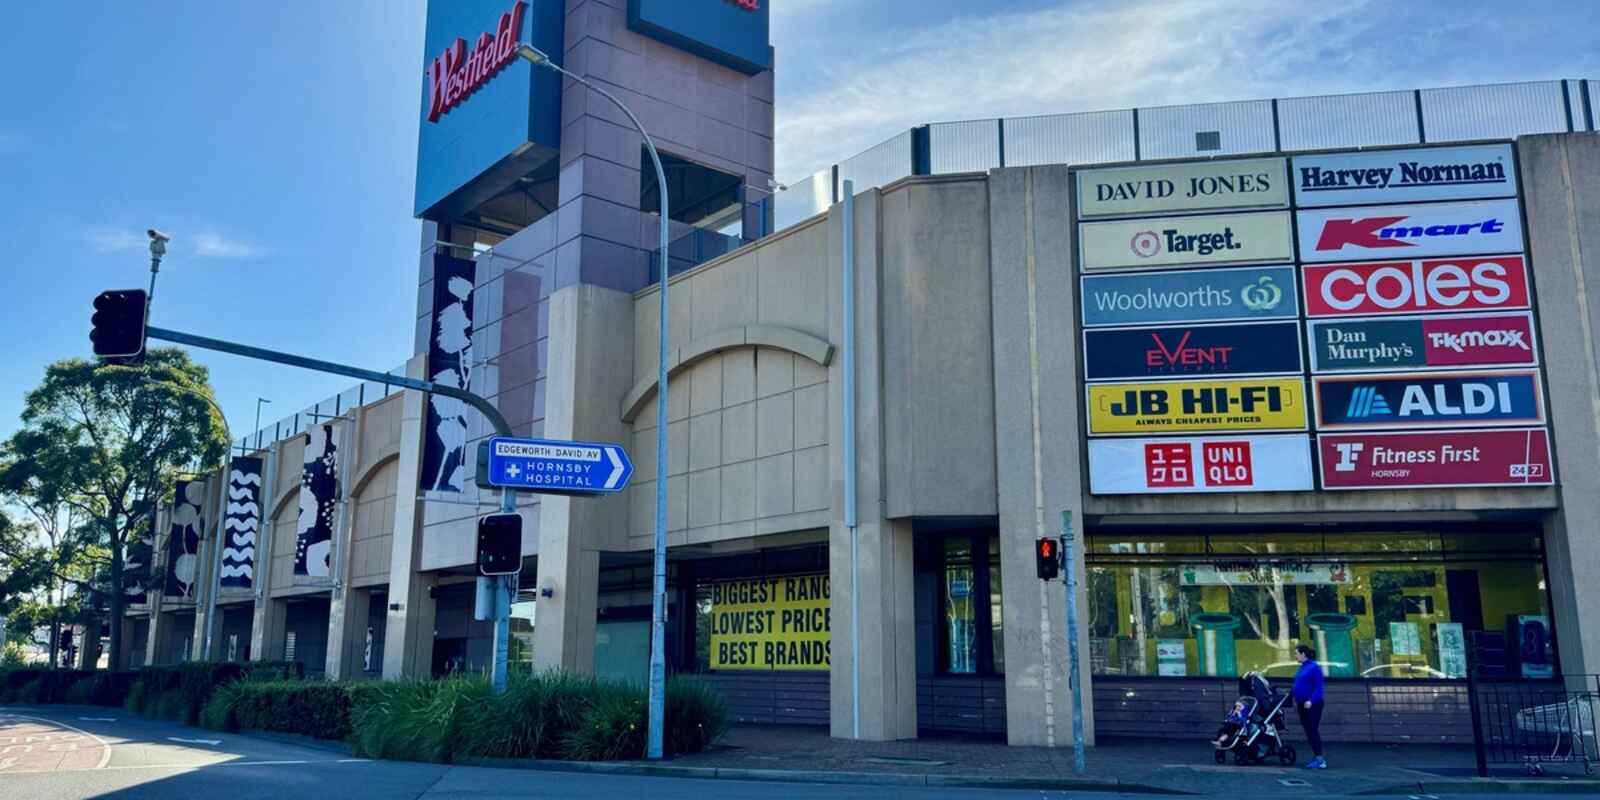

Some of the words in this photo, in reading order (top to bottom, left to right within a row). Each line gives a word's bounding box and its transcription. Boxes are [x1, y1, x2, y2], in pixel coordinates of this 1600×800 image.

[427, 0, 526, 122] Westfield
[1096, 179, 1174, 201] DAVID
[1186, 173, 1270, 198] JONES
[1300, 166, 1393, 189] Harvey
[1399, 161, 1505, 183] Norman
[1315, 215, 1505, 251] Kmart
[1320, 259, 1510, 311] coles
[1095, 285, 1232, 311] Woolworths
[1326, 328, 1366, 343] Dan
[1147, 331, 1232, 365] EVENT
[1327, 342, 1413, 362] Murphy's
[1110, 389, 1169, 416] JB
[1182, 386, 1282, 414] HI-FI
[1399, 382, 1512, 416] ALDI
[1136, 418, 1172, 426] ALWAYS
[1175, 417, 1222, 425] CHEAPEST
[1226, 416, 1262, 424] PRICES
[498, 444, 550, 457] EDGEWORTH
[556, 447, 583, 458] DAVID
[587, 449, 599, 459] AV
[1208, 447, 1243, 464] UNI
[1372, 447, 1436, 466] Fitness
[1441, 445, 1480, 465] First
[527, 462, 592, 473] HORNSBY
[1210, 466, 1248, 484] QLO
[1371, 469, 1410, 479] HORNSBY
[526, 474, 592, 486] HOSPITAL
[713, 578, 779, 605] BIGGEST
[711, 610, 775, 635] LOWEST
[719, 641, 758, 665] BEST
